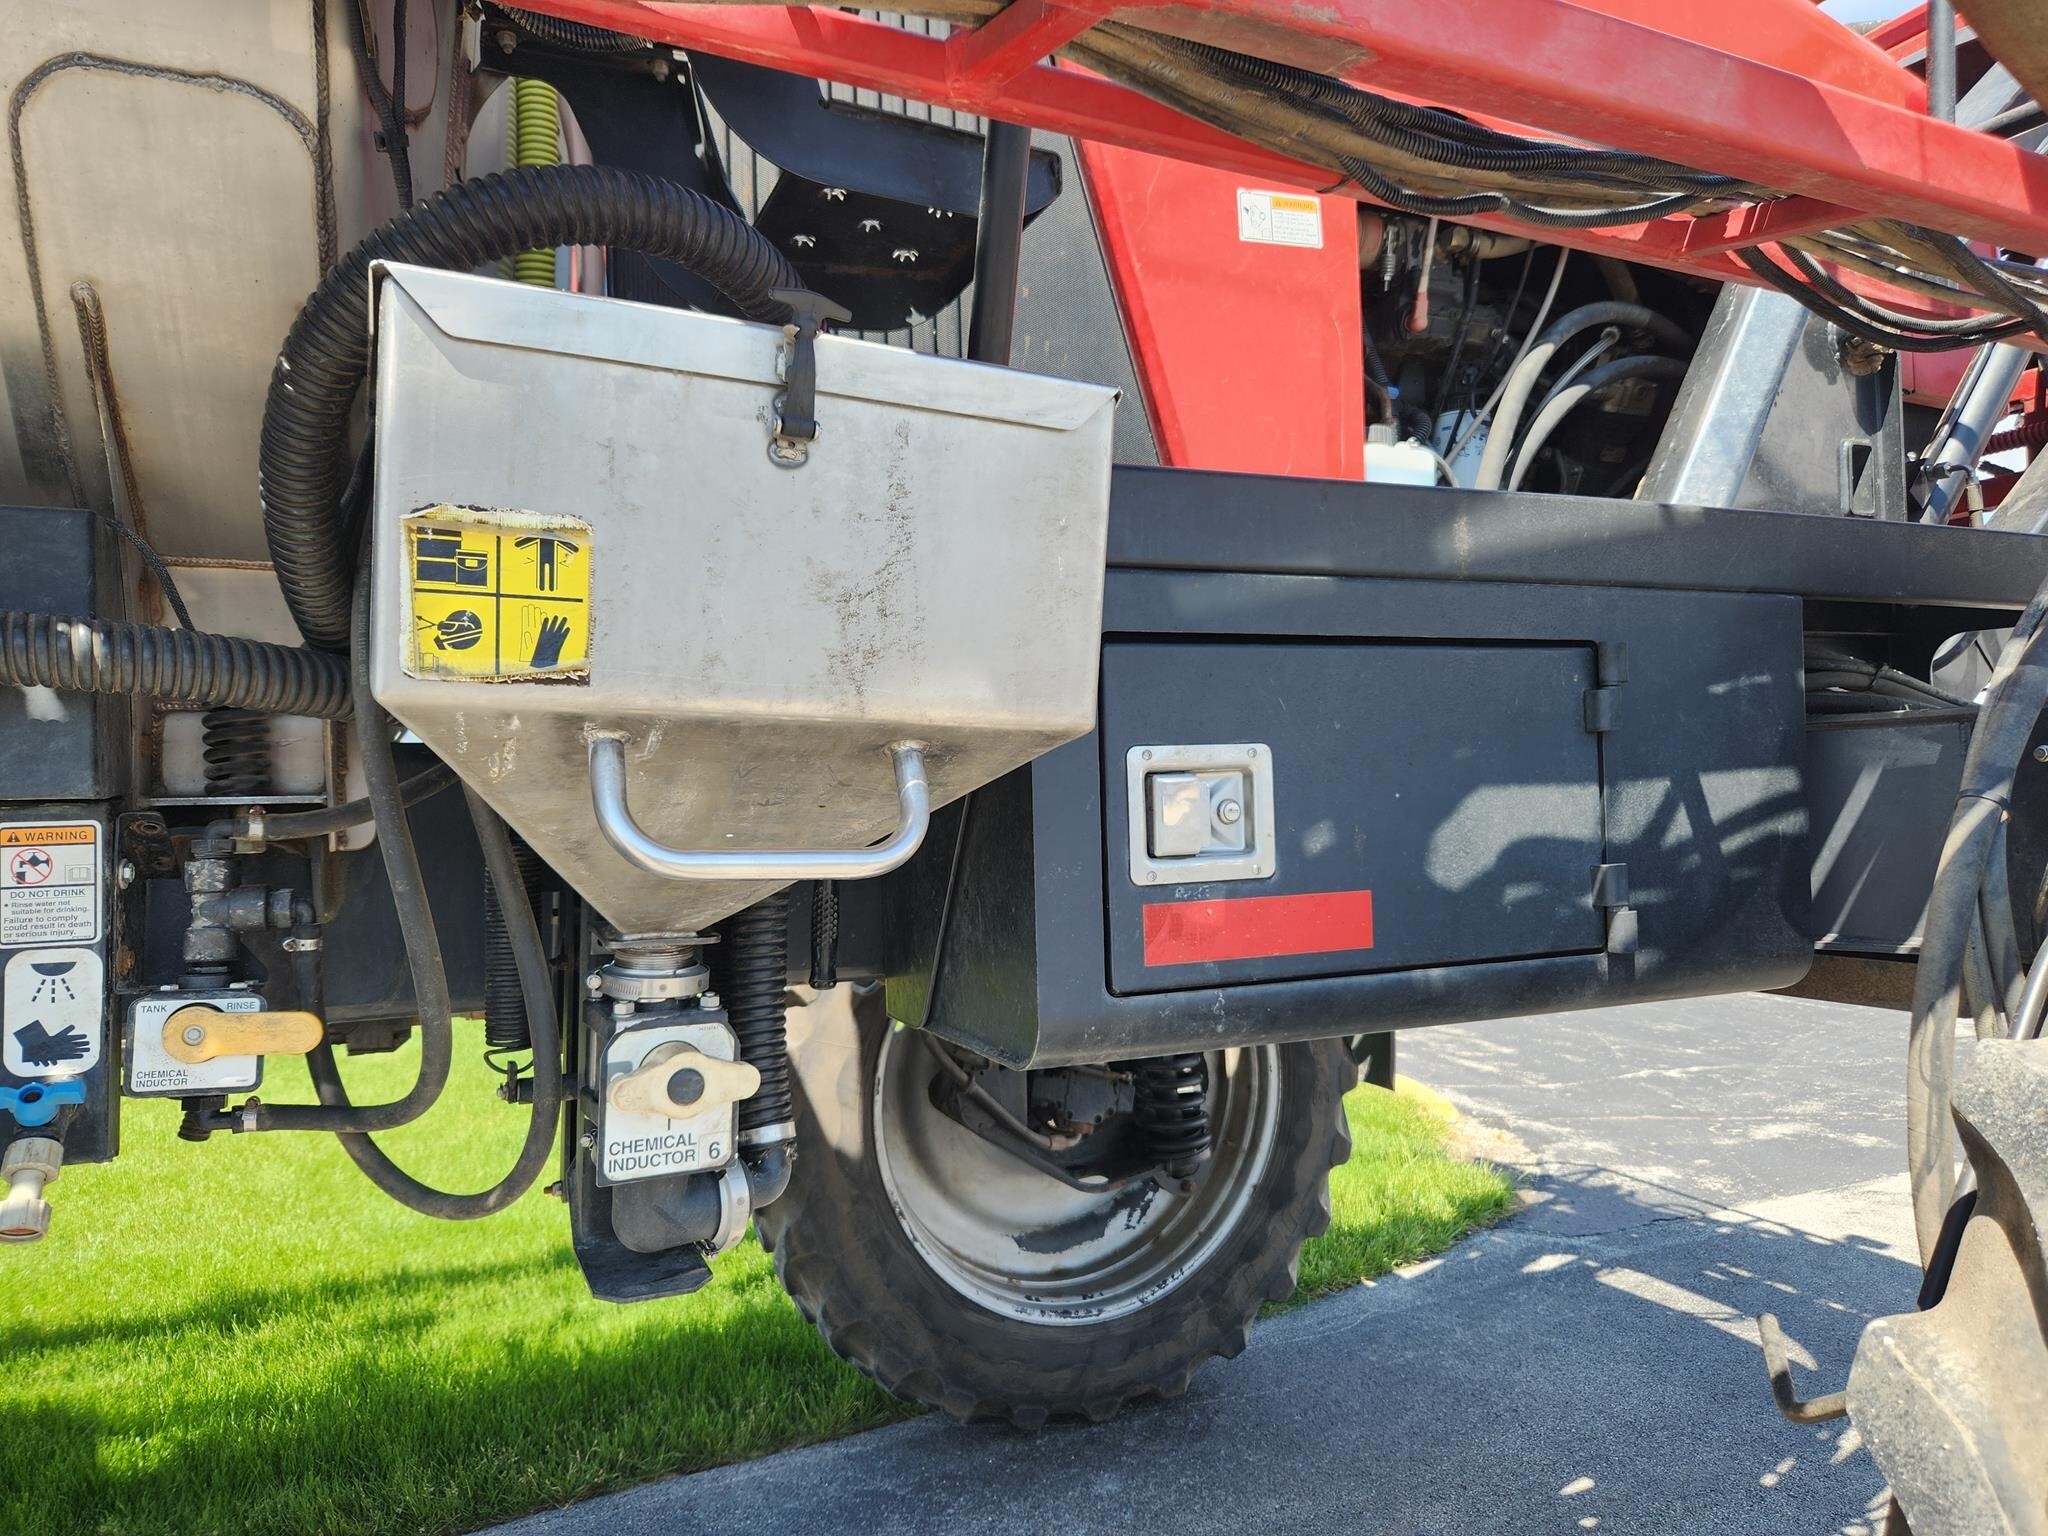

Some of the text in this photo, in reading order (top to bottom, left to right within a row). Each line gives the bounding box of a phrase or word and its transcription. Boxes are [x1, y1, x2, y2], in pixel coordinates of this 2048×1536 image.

[25, 831, 87, 841] WARNING
[10, 889, 86, 899] DO NOT DRINK
[4, 916, 33, 924] Failure
[47, 915, 78, 923] comply
[4, 923, 28, 931] could
[31, 922, 55, 930] result
[16, 930, 47, 938] serious
[50, 929, 76, 938] injury.
[141, 1005, 167, 1013] TANK
[226, 1001, 256, 1010] RINSE
[136, 1070, 189, 1079] CHEMICAL
[135, 1078, 188, 1088] INDUCTOR
[609, 1132, 697, 1156] CHEMICAL
[708, 1141, 720, 1160] 6
[608, 1149, 696, 1173] INDUCTOR
